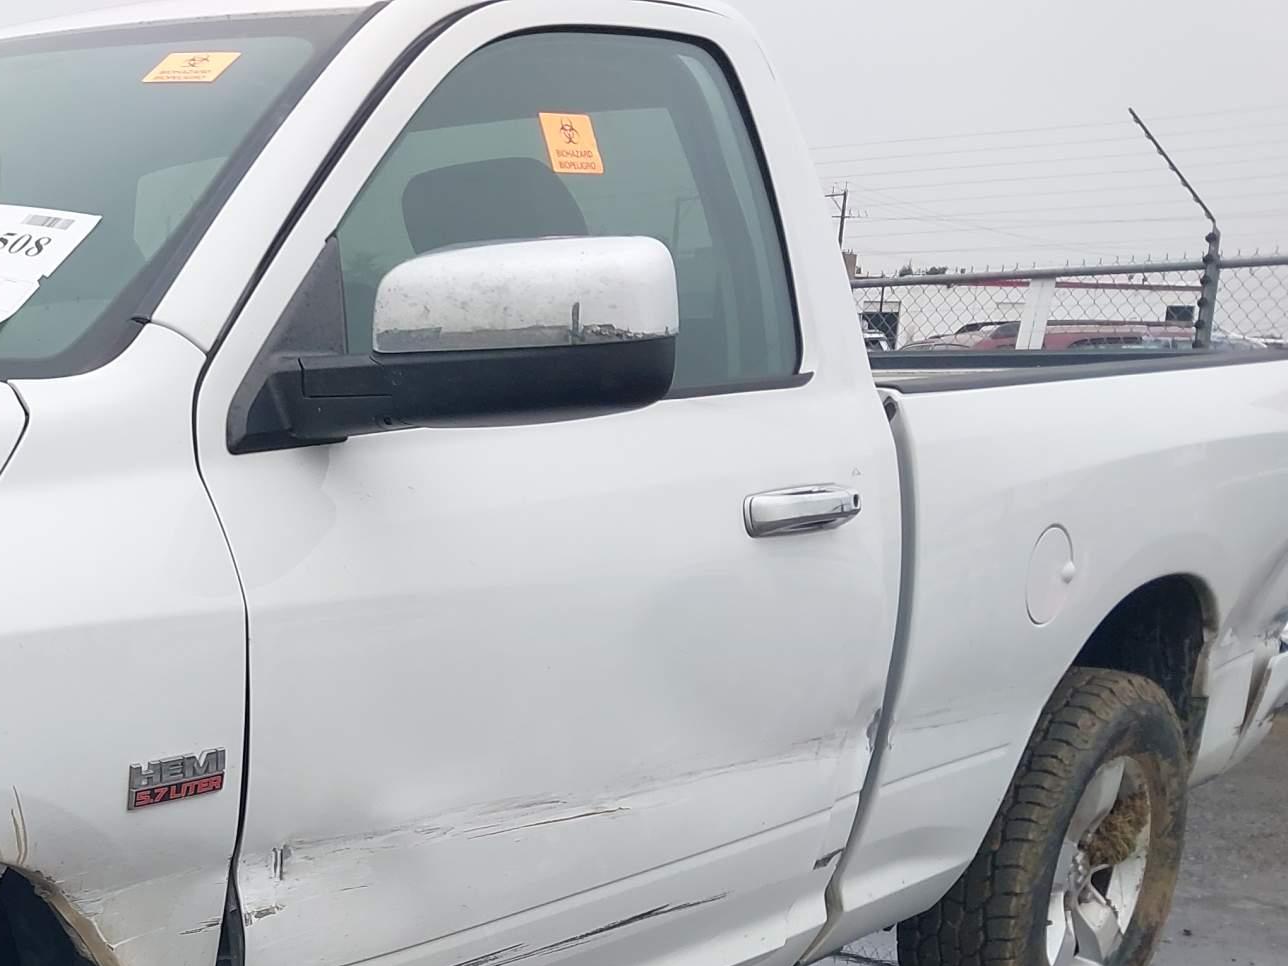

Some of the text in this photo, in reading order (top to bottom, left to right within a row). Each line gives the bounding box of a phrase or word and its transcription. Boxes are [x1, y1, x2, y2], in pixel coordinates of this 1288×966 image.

[555, 149, 594, 158] BIOHAZARD
[128, 746, 226, 790] HEMI
[135, 775, 223, 808] 5.7 LITER
